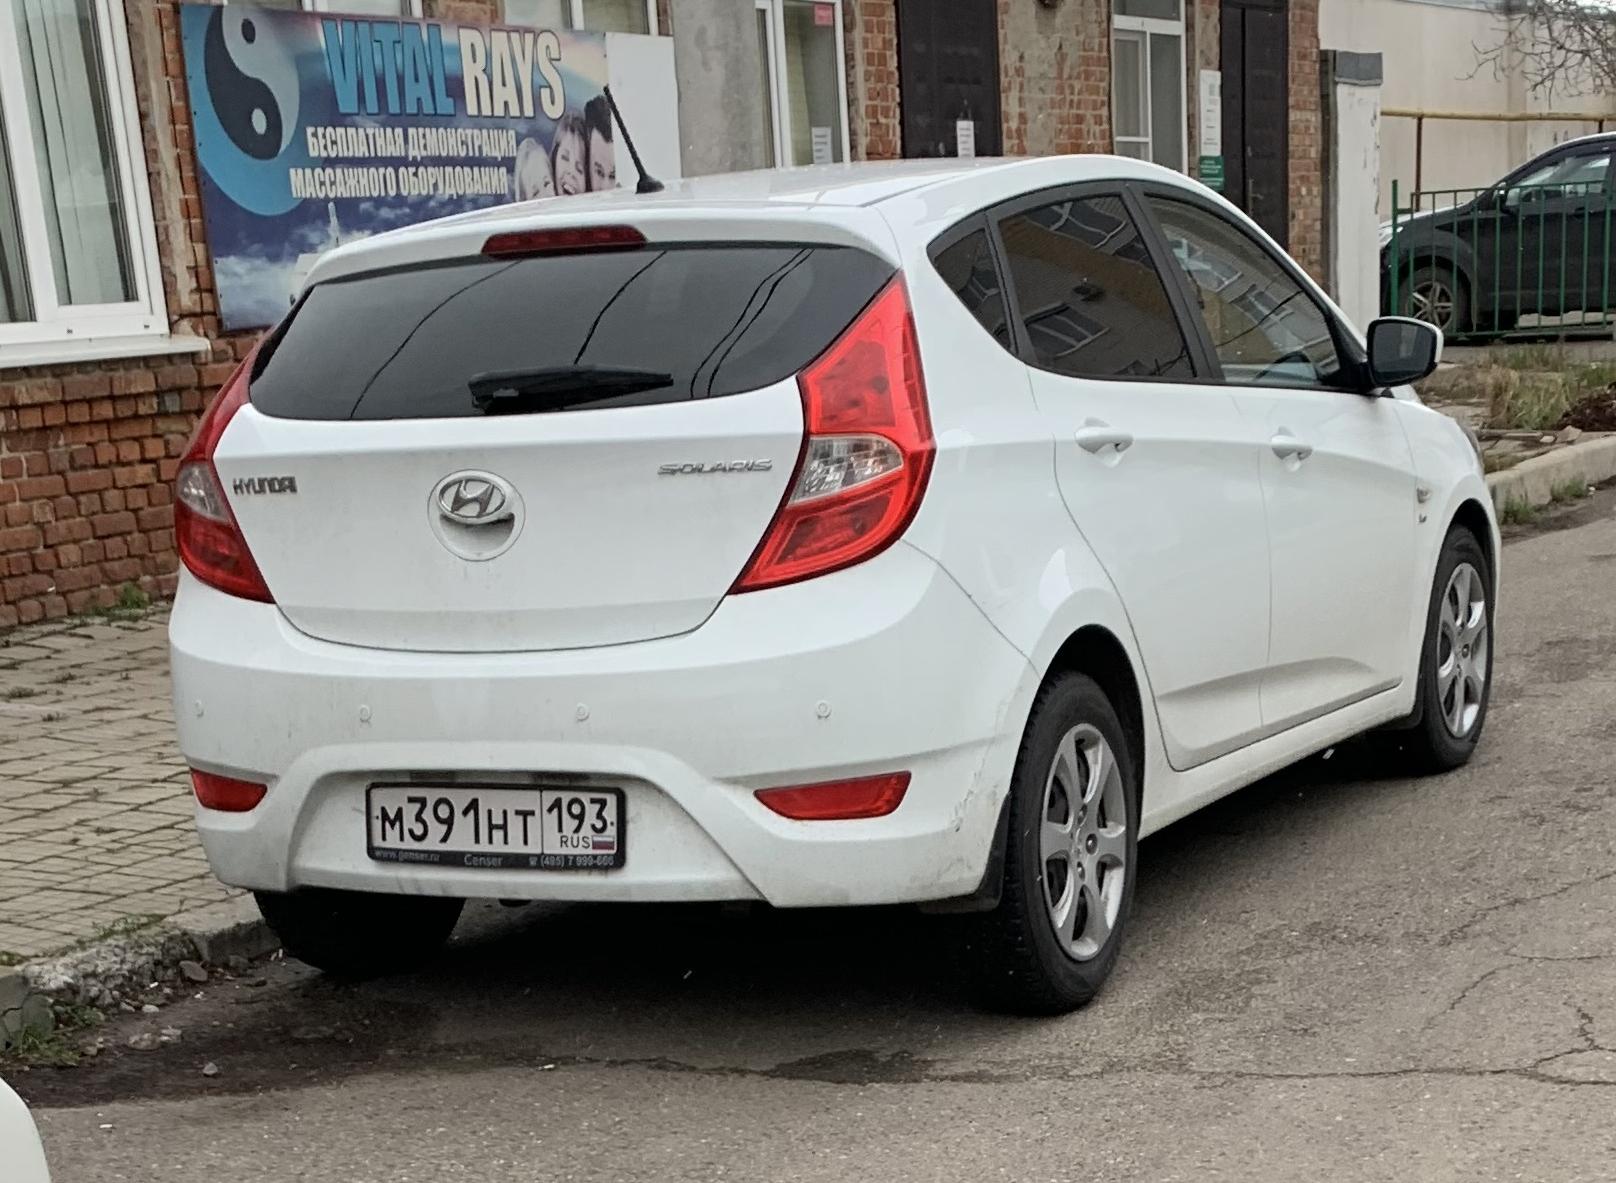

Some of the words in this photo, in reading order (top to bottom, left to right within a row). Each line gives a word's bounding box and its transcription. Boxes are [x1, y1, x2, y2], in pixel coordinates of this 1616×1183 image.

[321, 19, 457, 116] VITAL
[458, 26, 566, 120] RAYS
[305, 126, 405, 158] БЕСПЛАТНАЯ
[408, 127, 517, 161] ДЕМОНСТРАЦИЯ
[289, 166, 397, 199] МАССАЖНОГО
[399, 166, 509, 199] ОБОРУДОВАНИЯ
[658, 459, 772, 476] SOLARIS
[232, 476, 298, 495] HYUNDAI
[546, 797, 608, 835] 193
[560, 836, 591, 849] RUS
